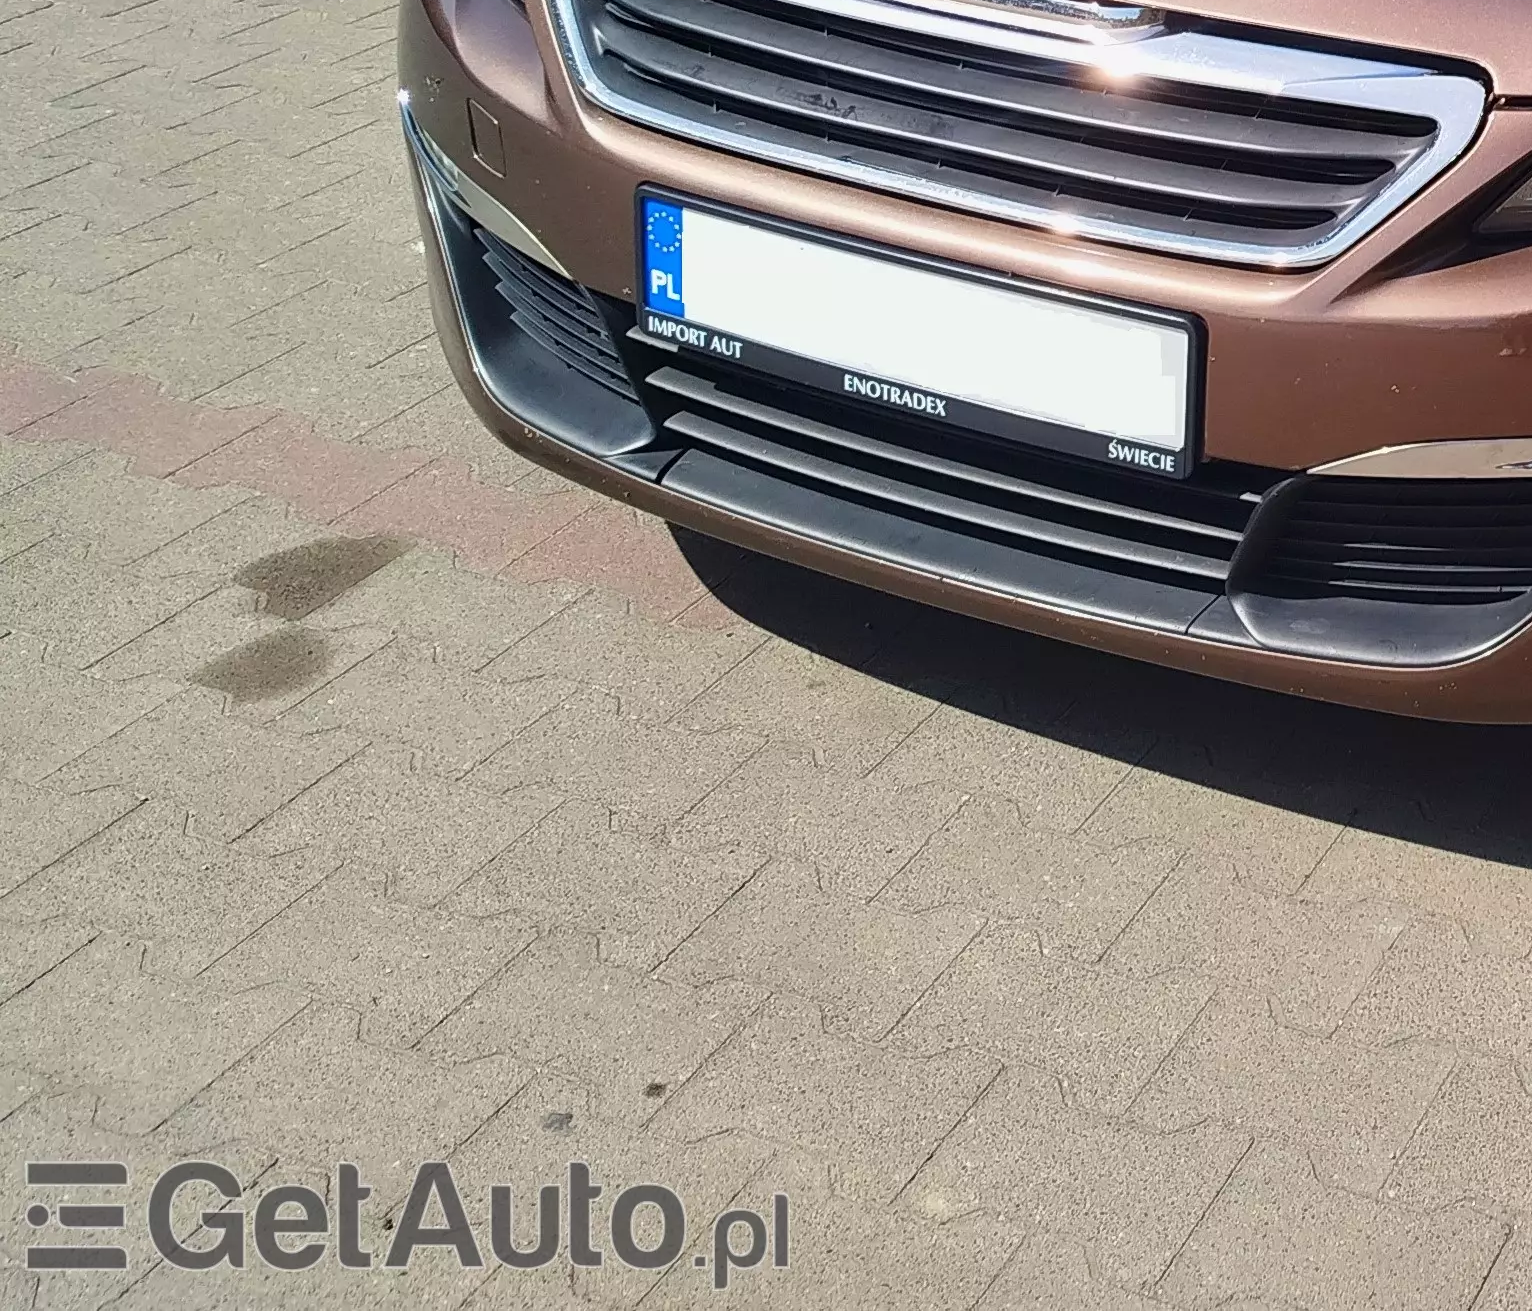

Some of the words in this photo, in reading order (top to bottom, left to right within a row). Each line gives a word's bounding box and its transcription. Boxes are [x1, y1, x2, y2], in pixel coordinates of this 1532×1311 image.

[651, 269, 680, 300] PL
[648, 317, 707, 347] IMPORT
[711, 335, 743, 359] AUT
[844, 375, 946, 416] ENOTRADEX
[1108, 440, 1175, 472] ŚWIECIE
